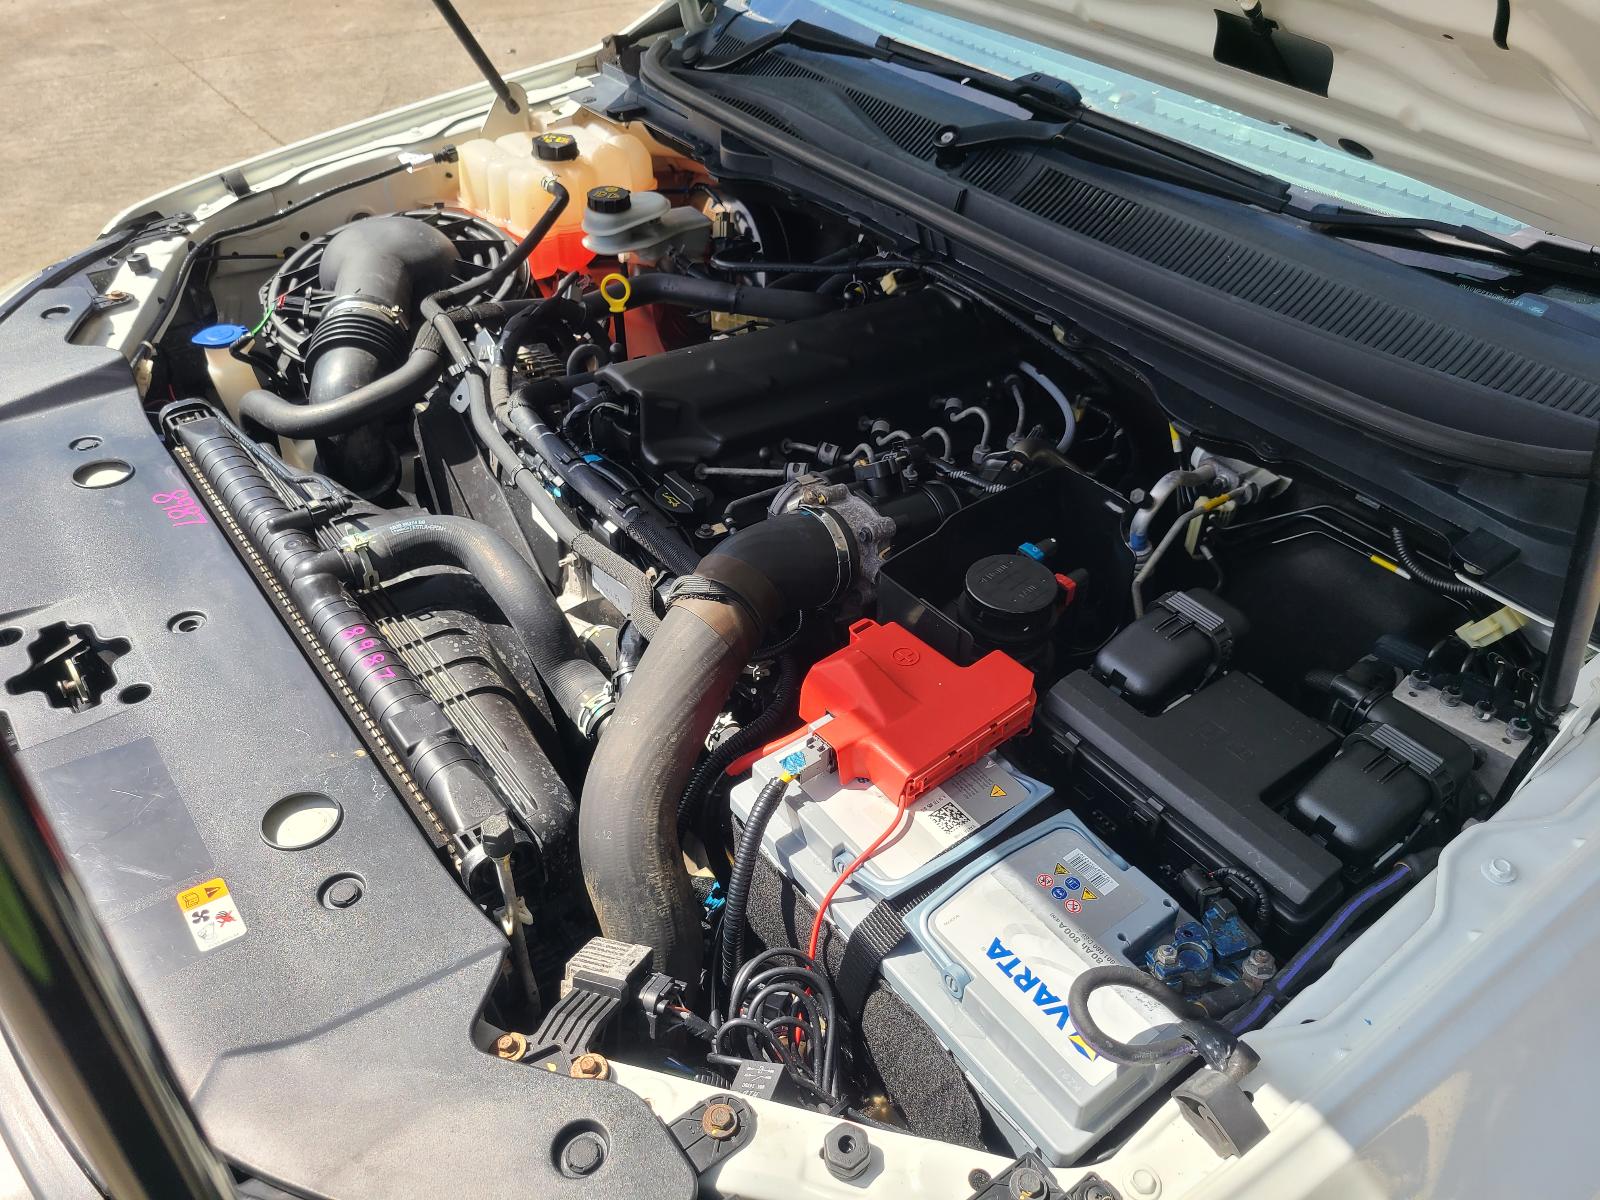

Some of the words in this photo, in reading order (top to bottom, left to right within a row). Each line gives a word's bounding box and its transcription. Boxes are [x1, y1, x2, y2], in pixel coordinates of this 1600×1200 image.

[152, 489, 208, 527] 8987
[341, 624, 397, 680] 8987
[986, 936, 1069, 1031] VARTA
